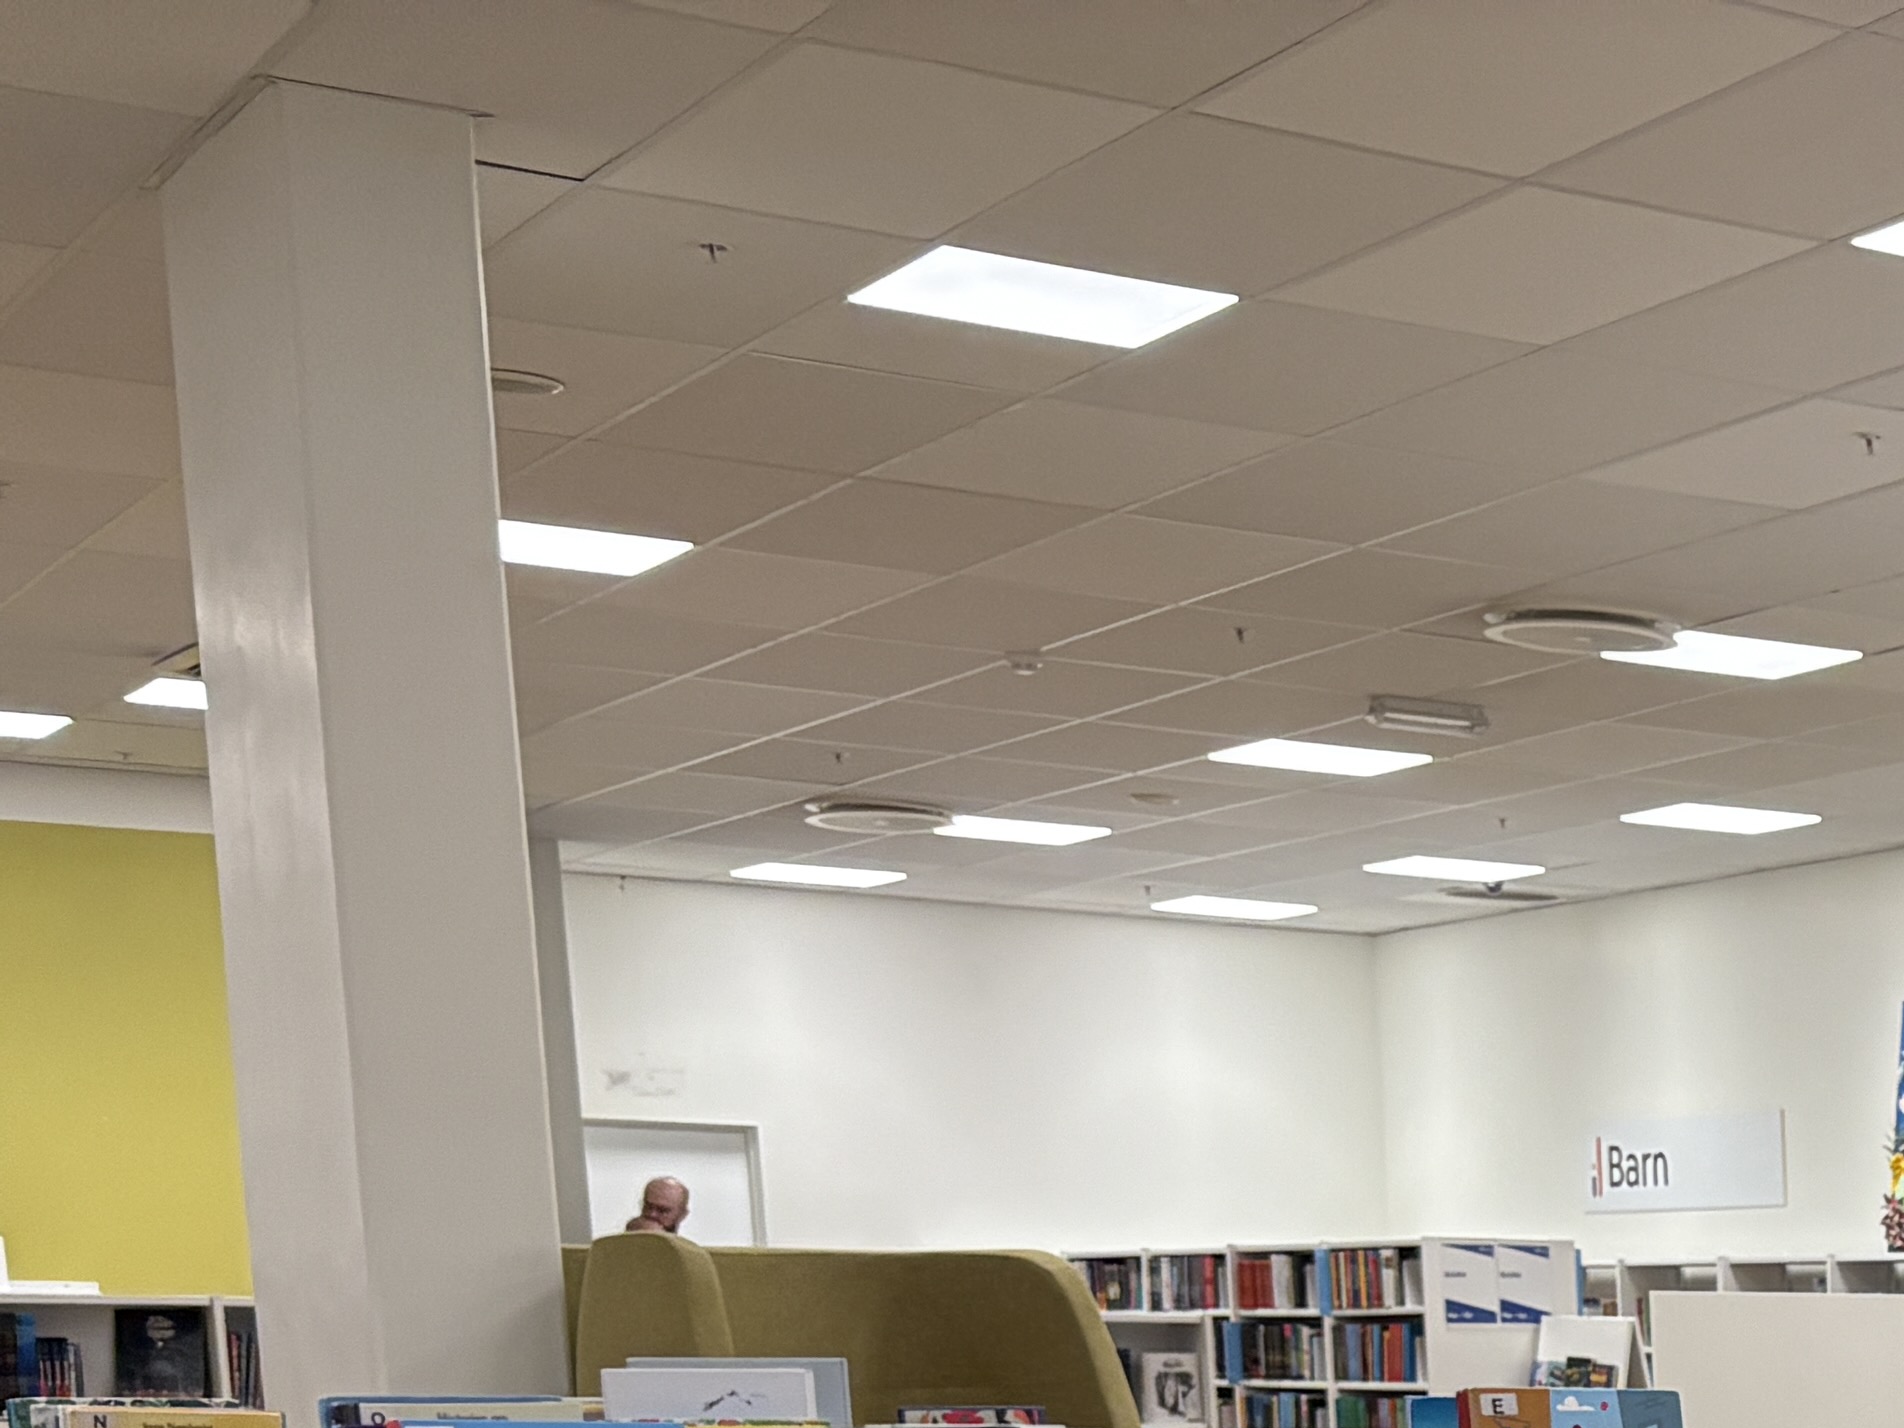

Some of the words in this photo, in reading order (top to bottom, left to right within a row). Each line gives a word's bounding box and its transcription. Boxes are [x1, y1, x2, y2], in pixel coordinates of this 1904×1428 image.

[1608, 1145, 1669, 1190] Barn
[1492, 1398, 1505, 1415] E
[93, 1414, 107, 1428] N
